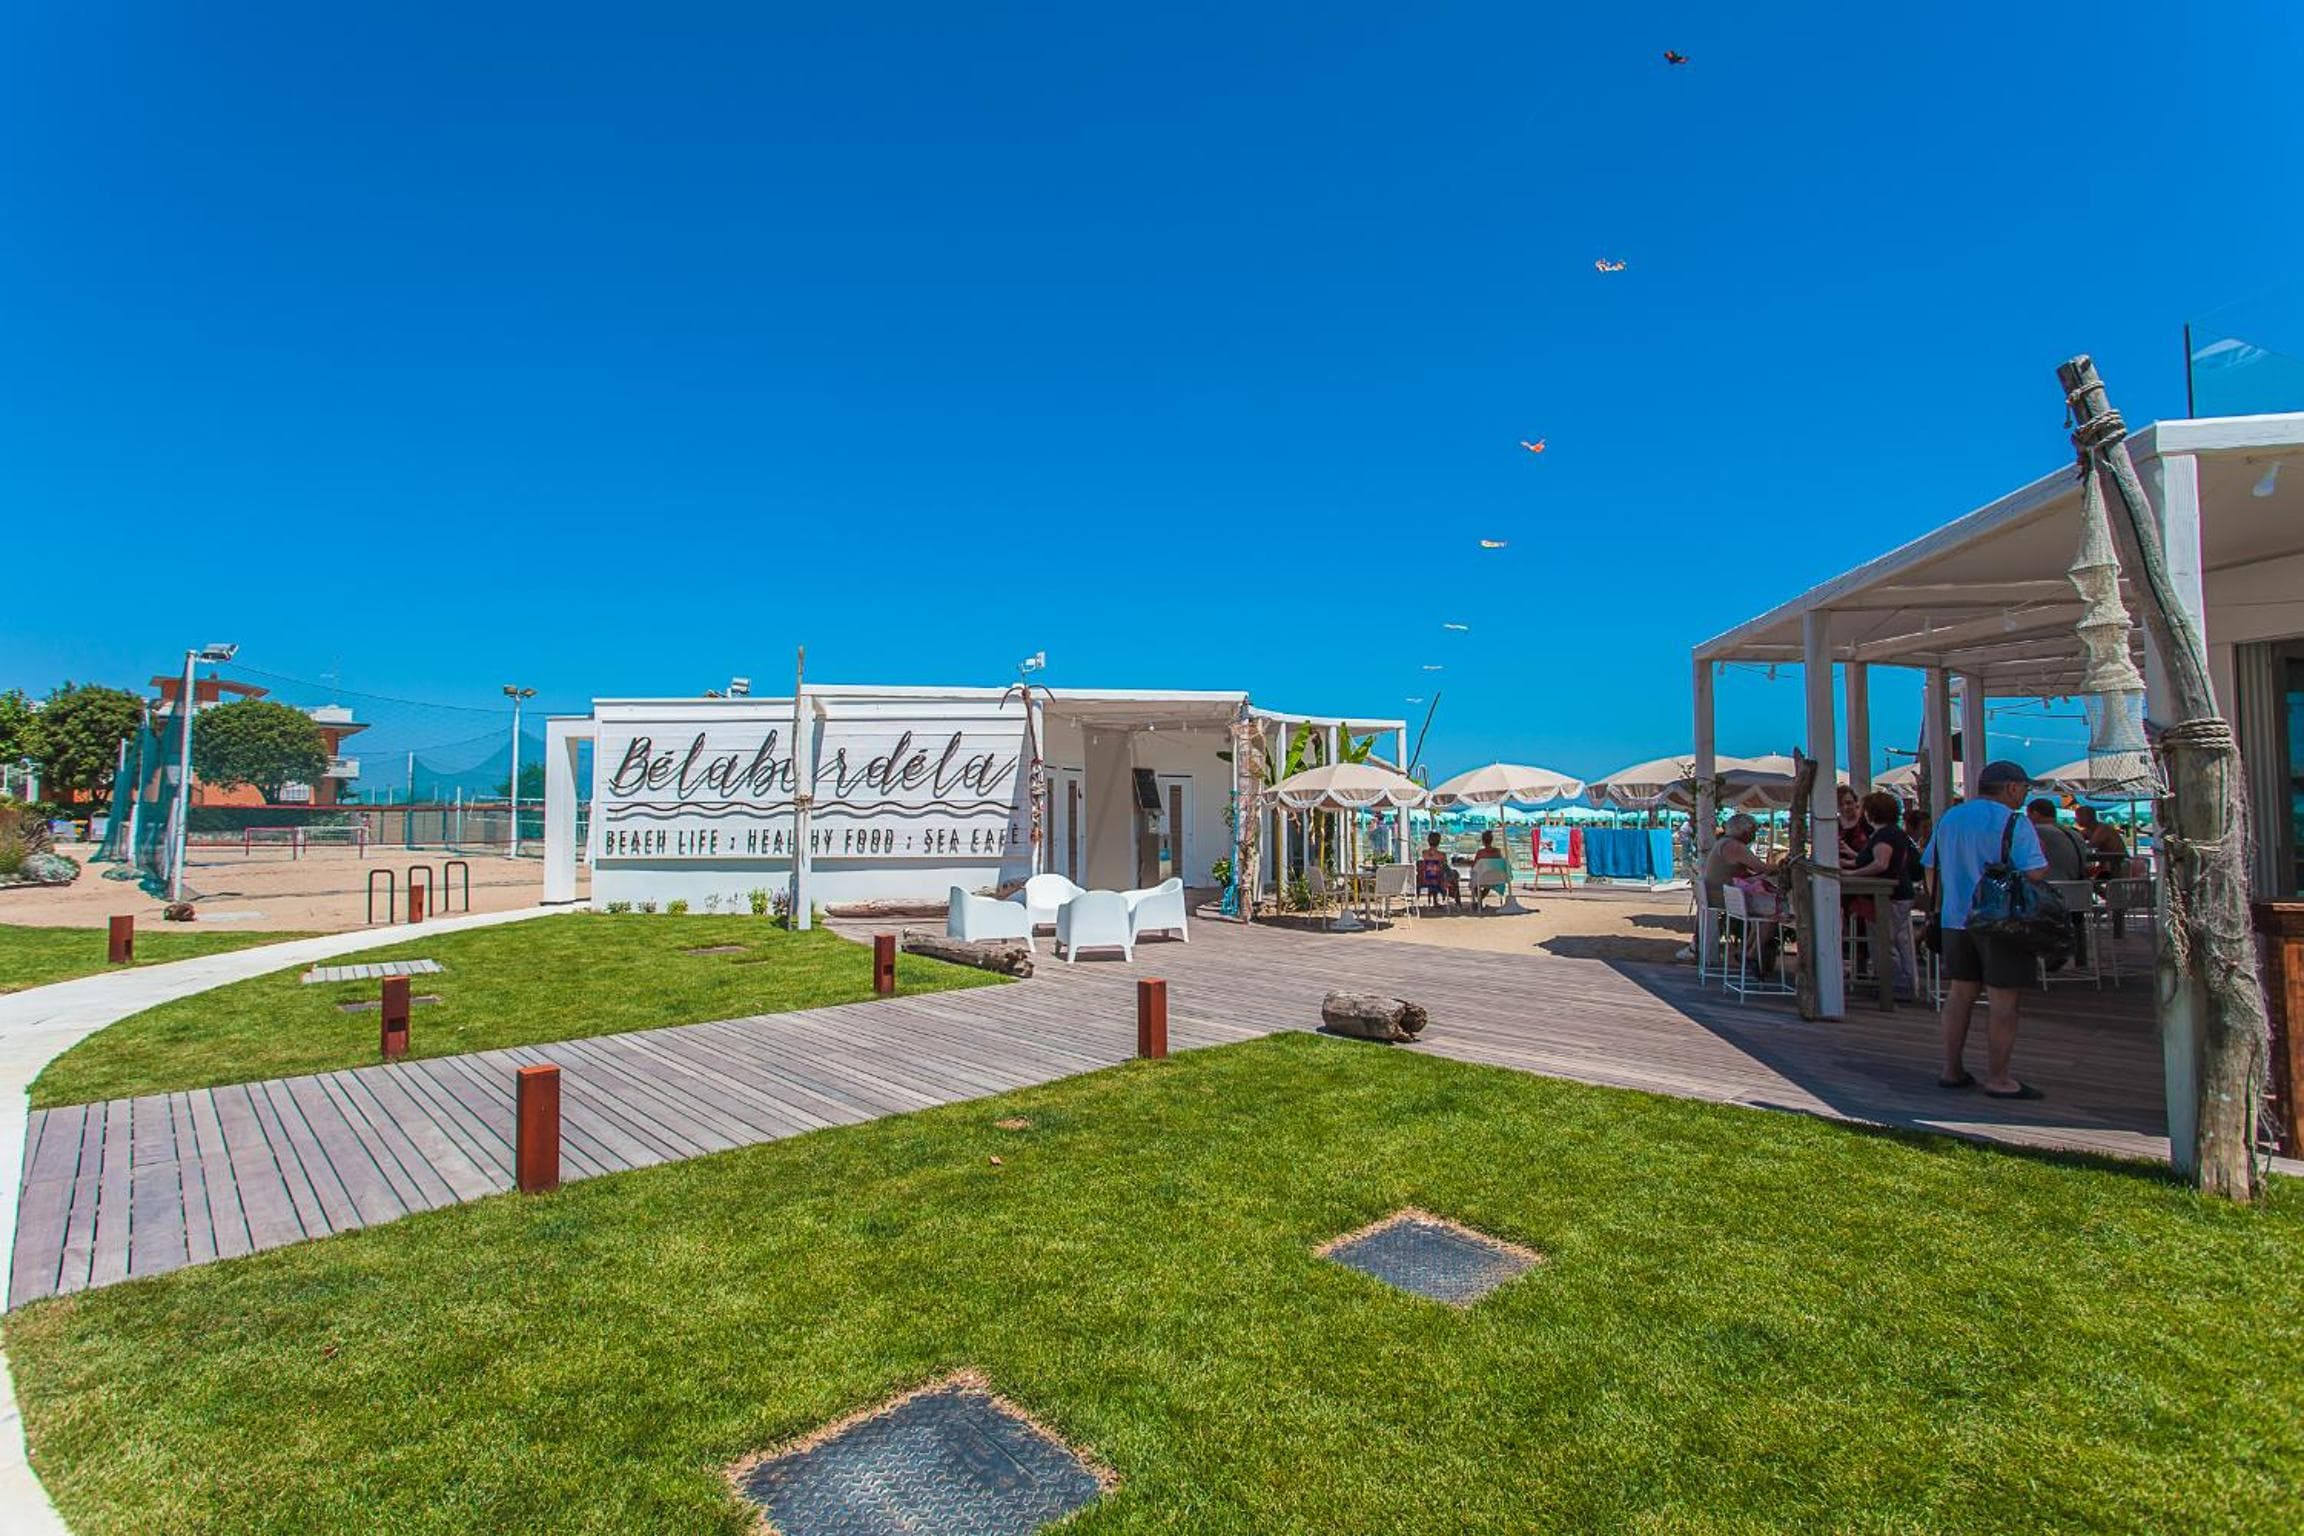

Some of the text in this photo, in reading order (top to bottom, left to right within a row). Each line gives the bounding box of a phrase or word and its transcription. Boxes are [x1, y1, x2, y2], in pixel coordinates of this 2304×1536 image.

[606, 830, 666, 848] BEACH
[678, 829, 718, 848] LIFE
[748, 829, 834, 848] HEALHY
[845, 829, 894, 847] FOOD
[925, 829, 960, 847] SEA
